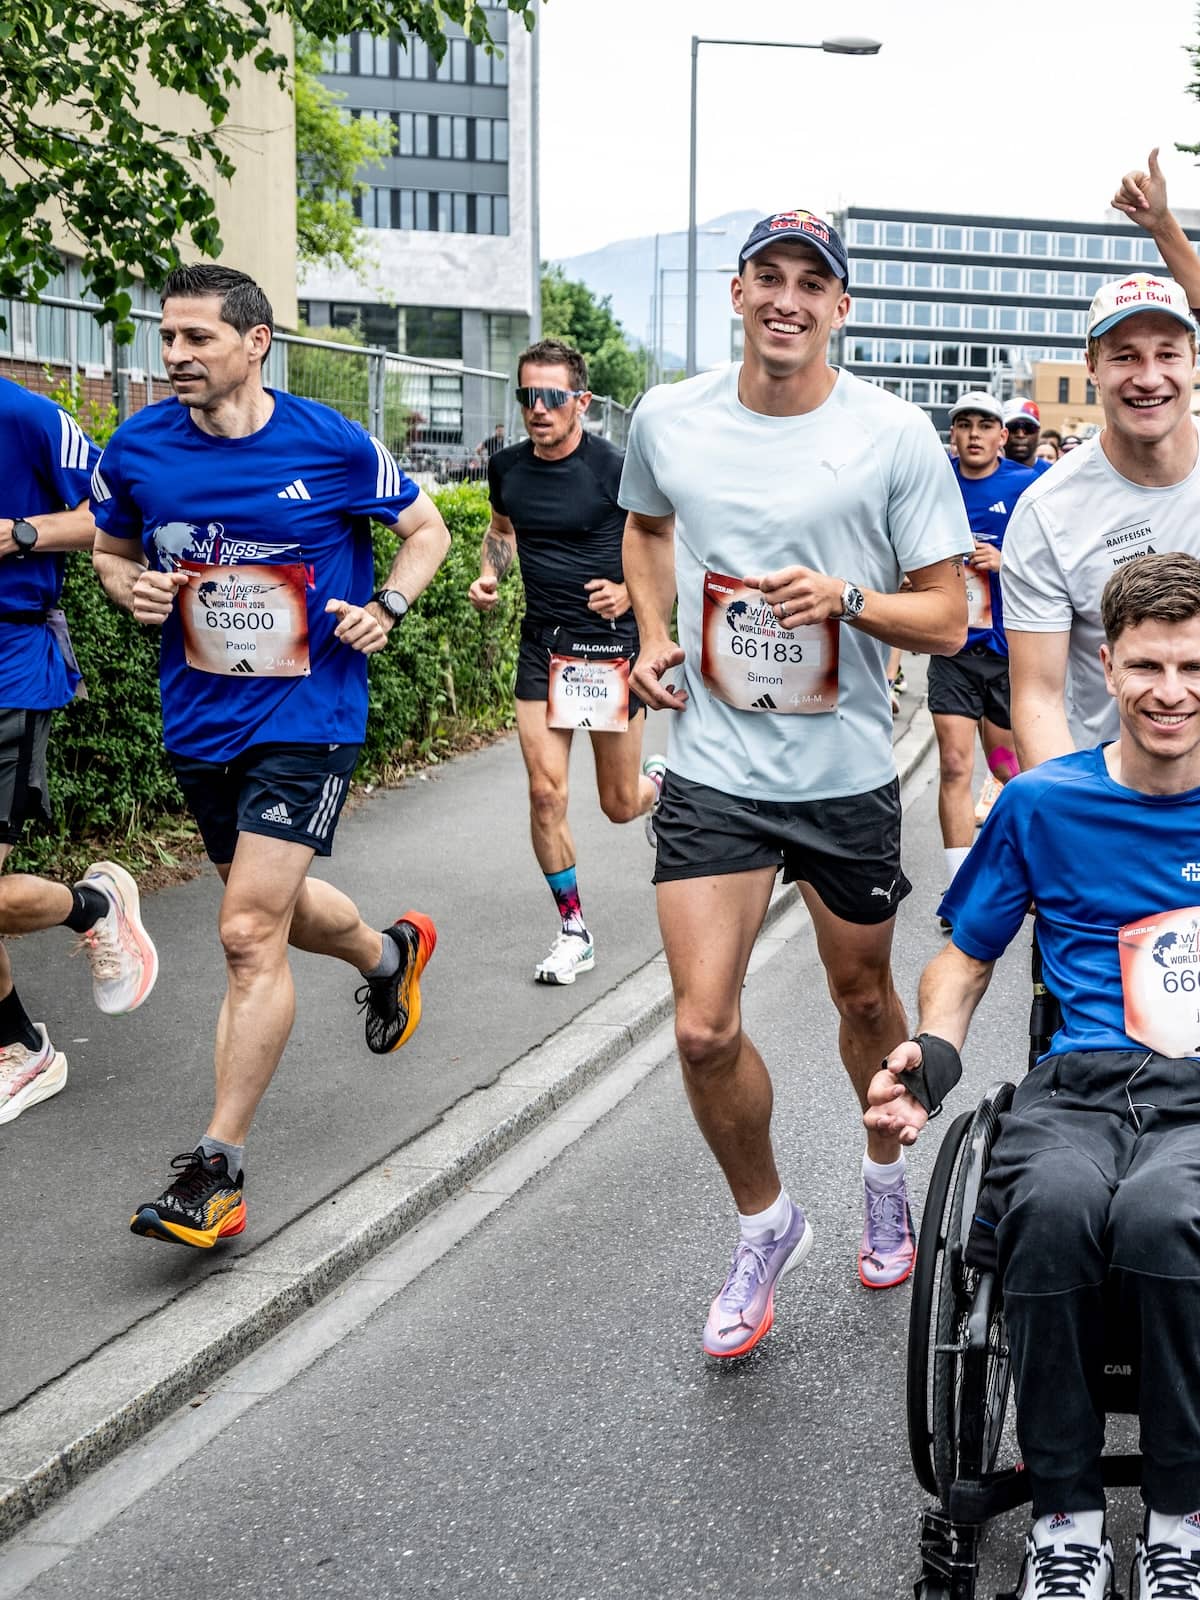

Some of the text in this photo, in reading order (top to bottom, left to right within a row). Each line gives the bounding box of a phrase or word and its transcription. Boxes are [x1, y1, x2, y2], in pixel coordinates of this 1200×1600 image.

[769, 219, 830, 244] Red Bull
[1115, 291, 1172, 306] Red Bull
[1105, 526, 1152, 548] RAIFFEISEN
[194, 537, 259, 557] WINGS
[1112, 550, 1146, 566] helvetia
[219, 583, 261, 594] WINGS
[226, 592, 249, 601] LIFE
[249, 601, 265, 609] 2026
[206, 611, 274, 630] 63600
[750, 606, 778, 621] WIN
[754, 617, 777, 629] LIFE
[777, 630, 795, 640] 2026
[226, 641, 257, 651] Paolo
[571, 643, 624, 653] SALOMON
[731, 635, 803, 664] 66183
[747, 671, 783, 685] Simon
[565, 684, 608, 699] 61304
[260, 812, 293, 825] adidas
